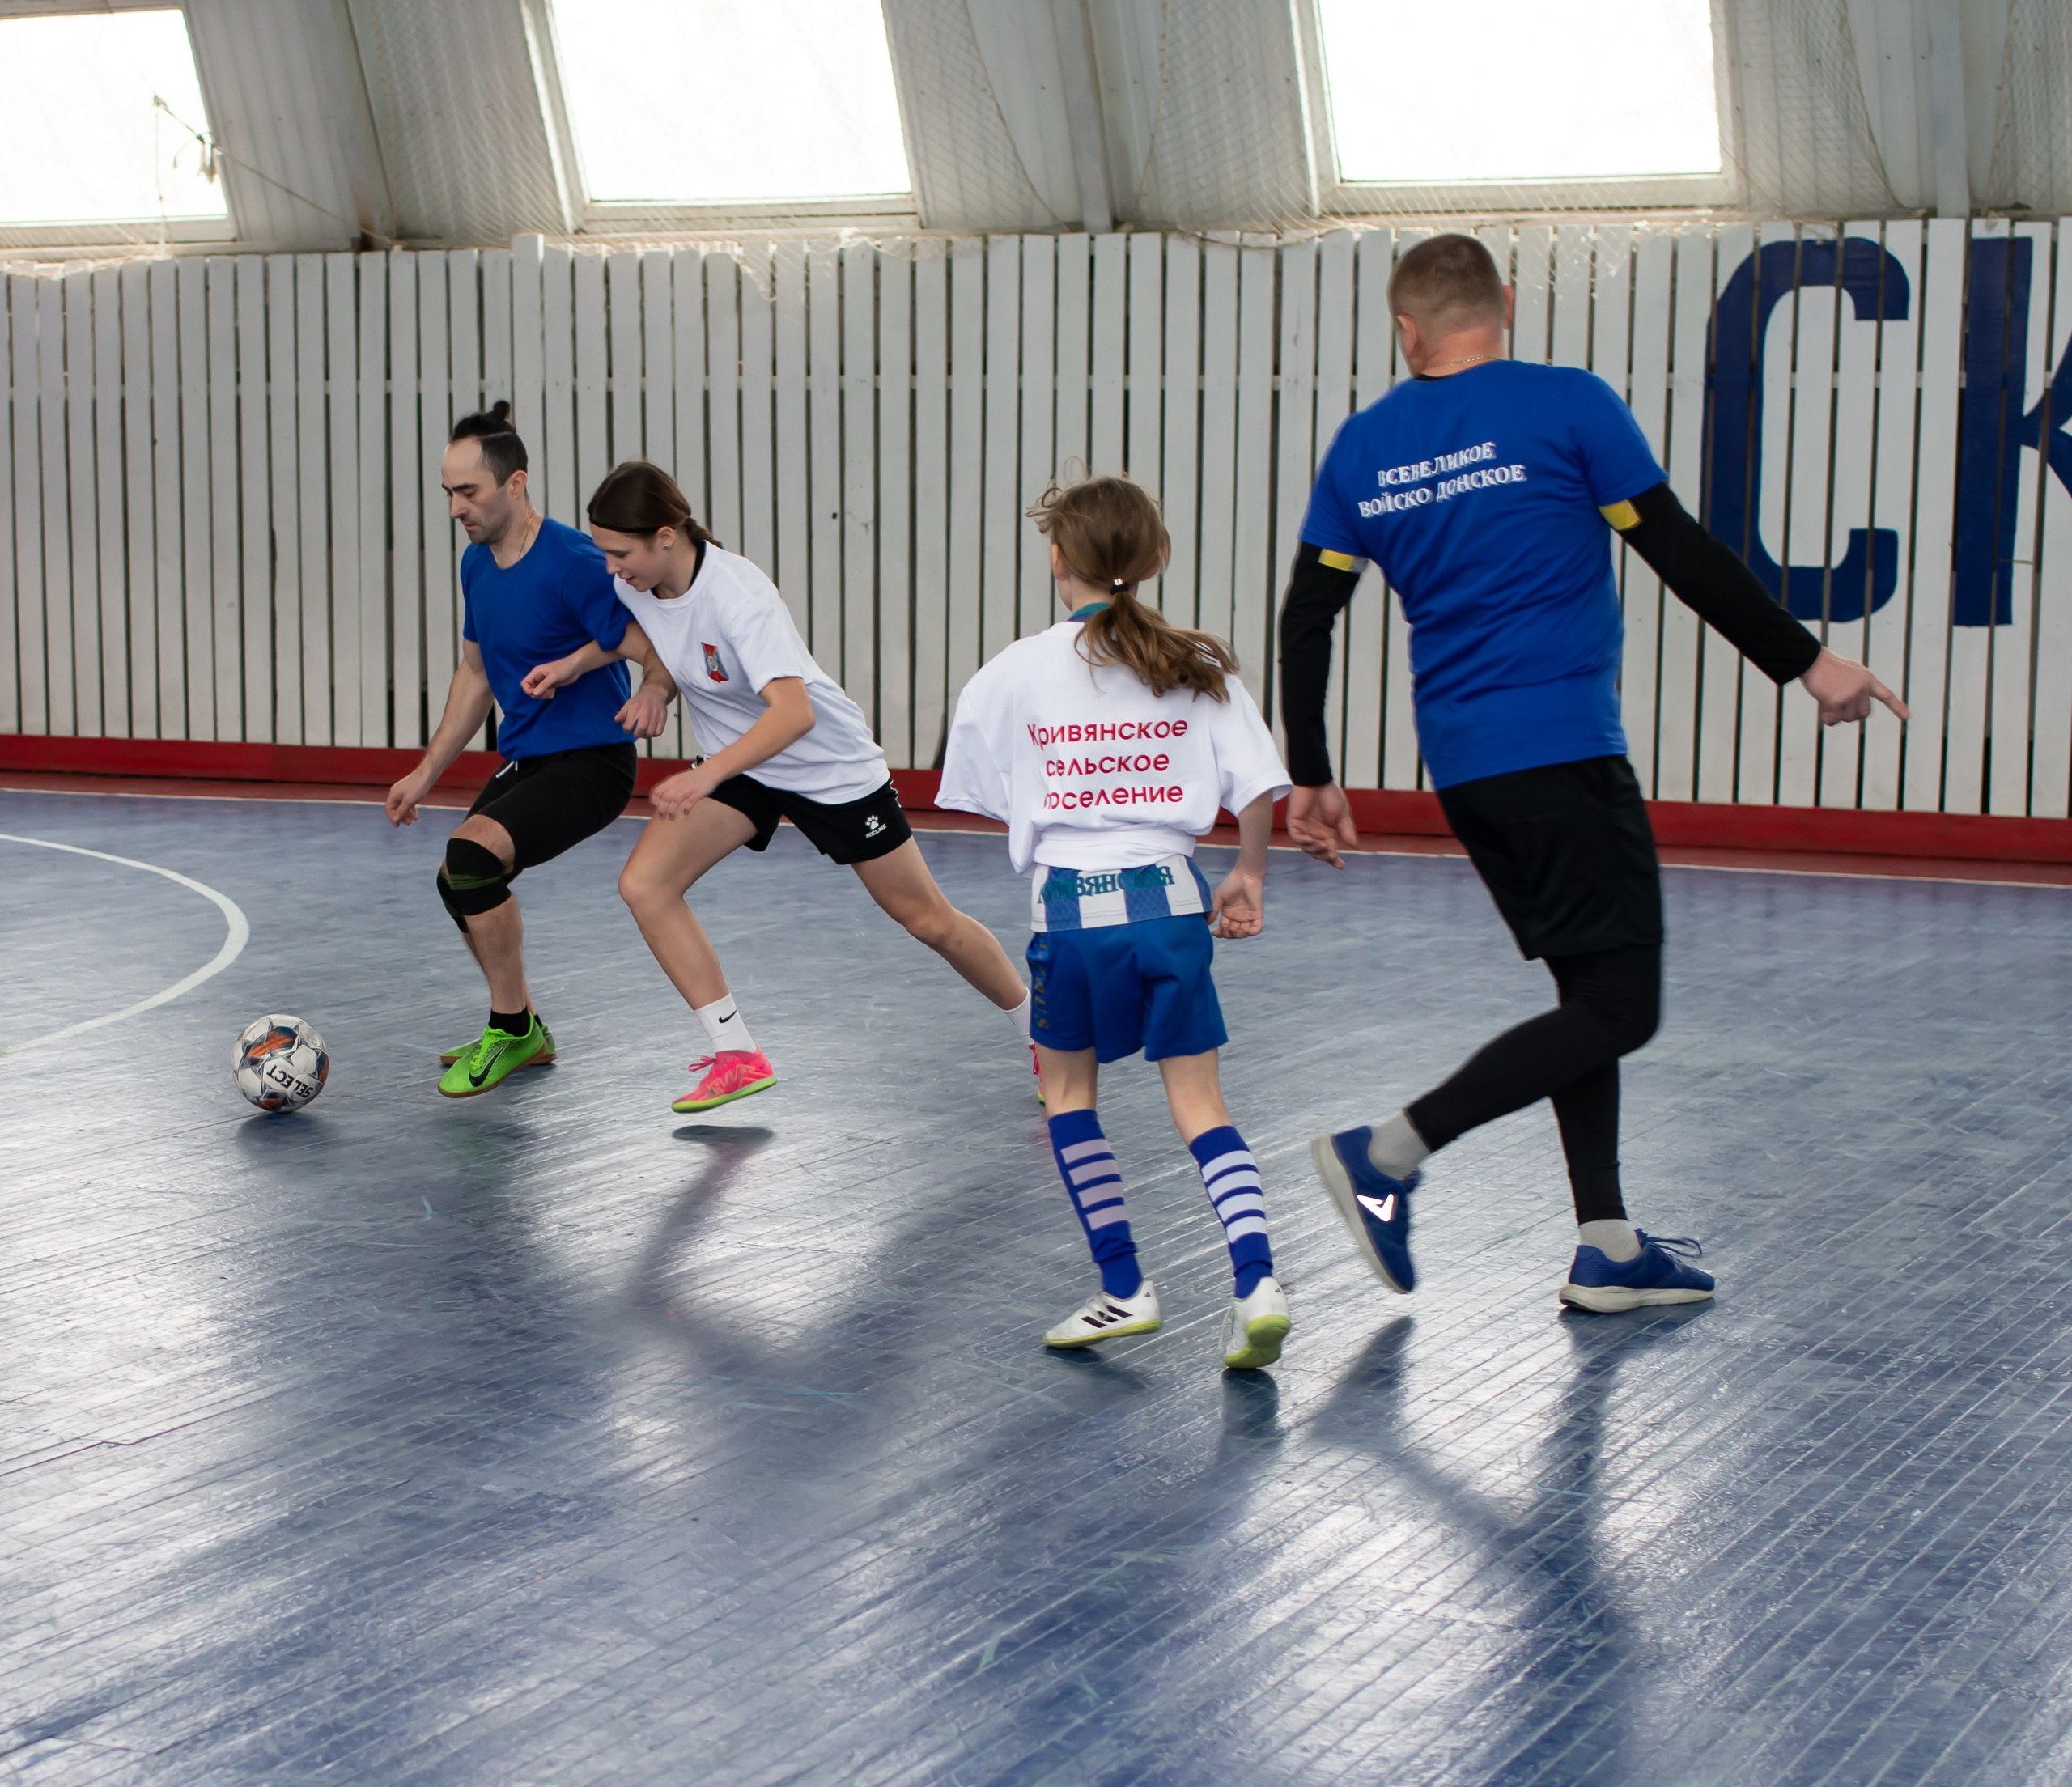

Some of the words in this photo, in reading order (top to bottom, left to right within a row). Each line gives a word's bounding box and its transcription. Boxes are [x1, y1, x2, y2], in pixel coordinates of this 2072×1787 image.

[1377, 441, 1497, 487] ВСЕВЕЛИКОЕ
[1357, 487, 1433, 518] ВОЙСКО
[1436, 464, 1528, 503] ДОНСКОЕ
[1026, 719, 1188, 751] Кривянское
[1046, 753, 1170, 777] сельское
[1042, 785, 1183, 810] поселение
[266, 1065, 315, 1098] SELECT
